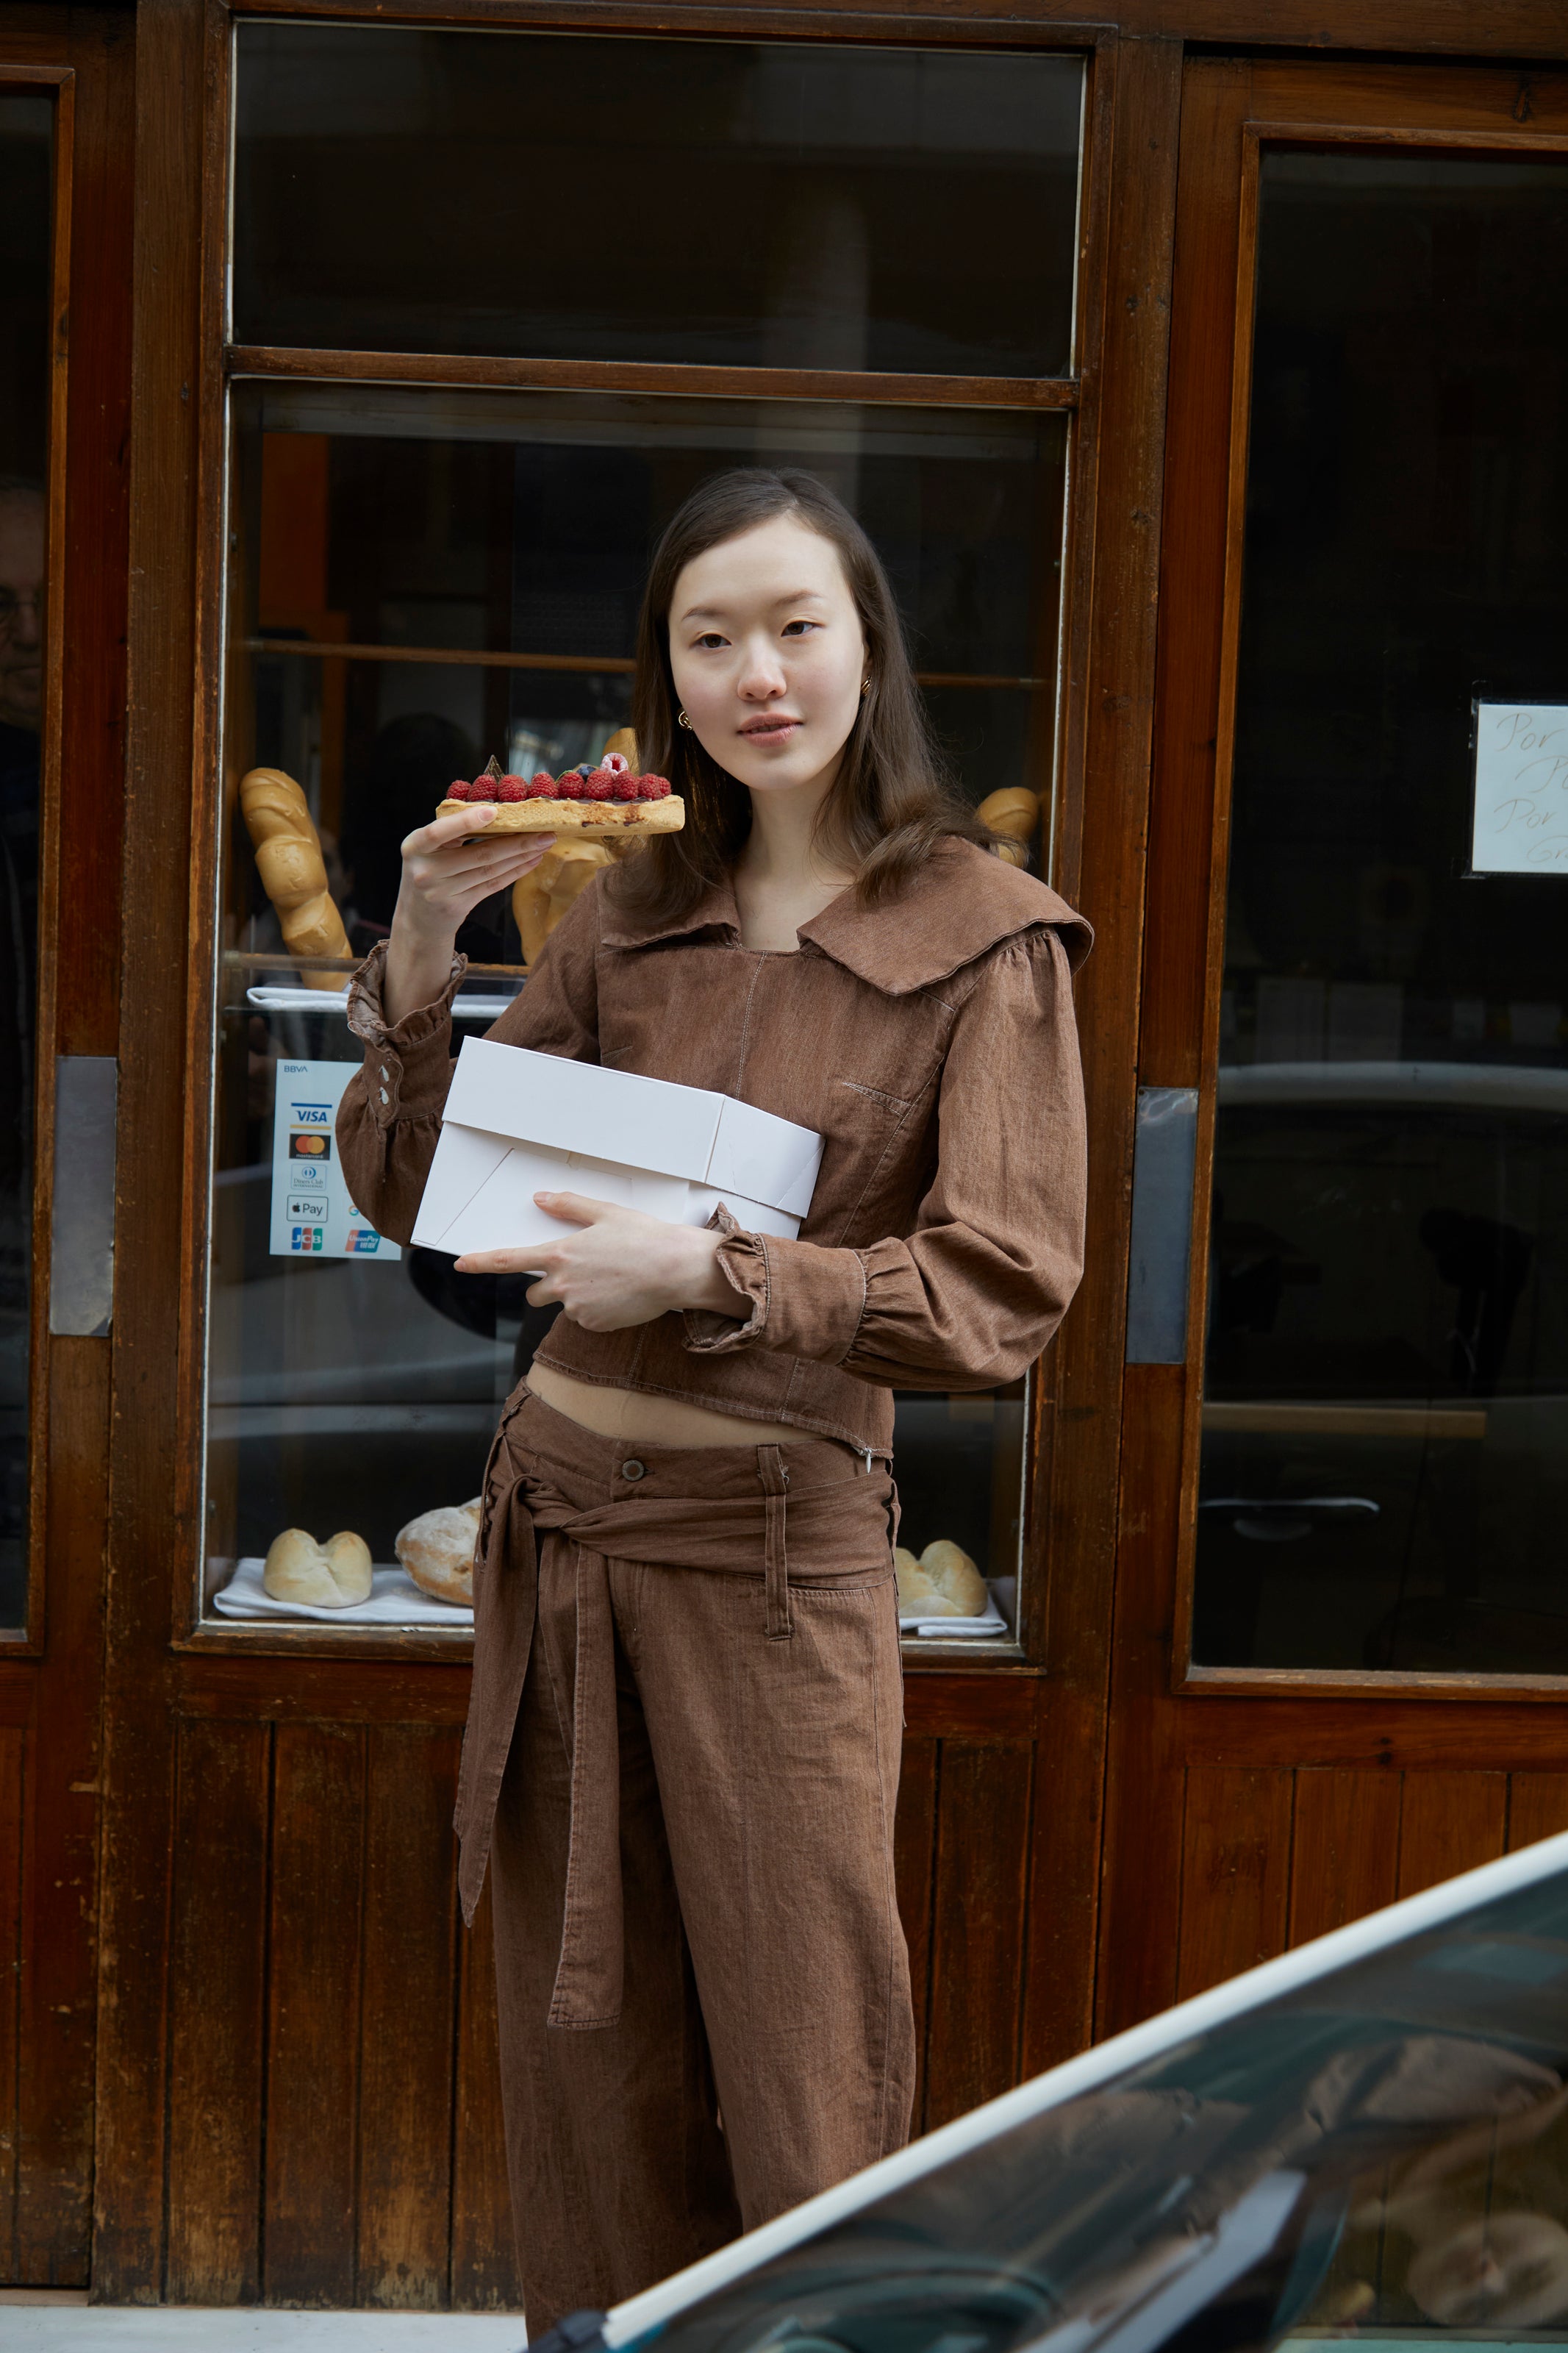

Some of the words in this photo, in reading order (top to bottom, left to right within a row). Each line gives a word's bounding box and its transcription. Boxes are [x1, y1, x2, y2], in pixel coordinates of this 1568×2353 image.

[1495, 713, 1566, 751] Por
[1494, 799, 1558, 833] Por
[284, 1065, 308, 1073] BBVA
[296, 1110, 327, 1122] VISA
[302, 1203, 323, 1215] Pay
[348, 1235, 379, 1243] UnionPay
